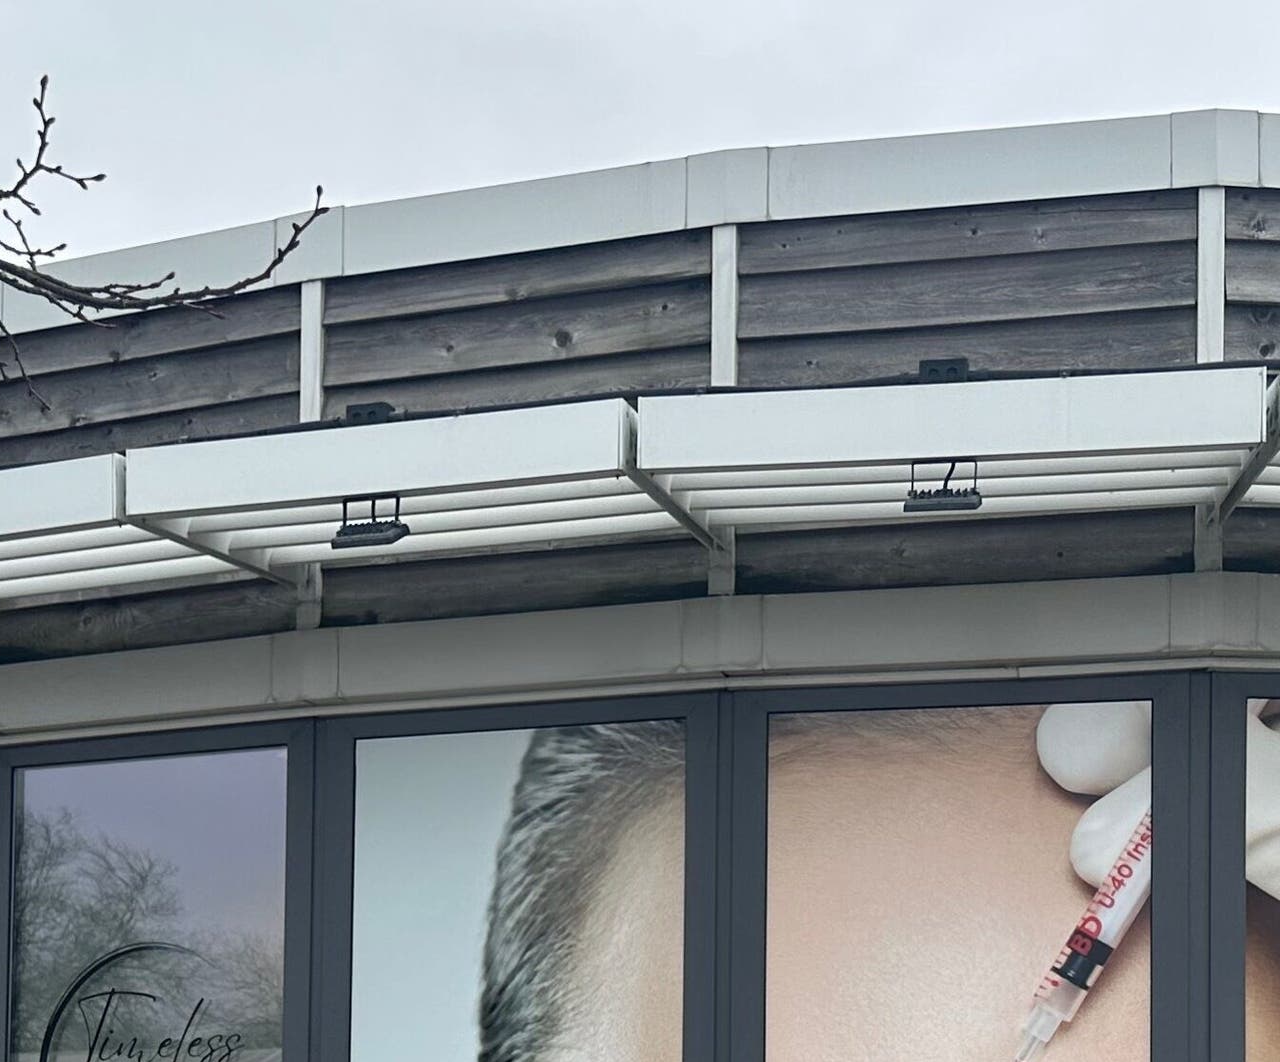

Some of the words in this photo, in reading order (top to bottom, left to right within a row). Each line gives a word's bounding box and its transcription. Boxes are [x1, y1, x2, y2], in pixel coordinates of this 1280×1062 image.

[1070, 914, 1102, 956] BD
[1098, 864, 1133, 909] U-40
[1127, 824, 1152, 862] Ins
